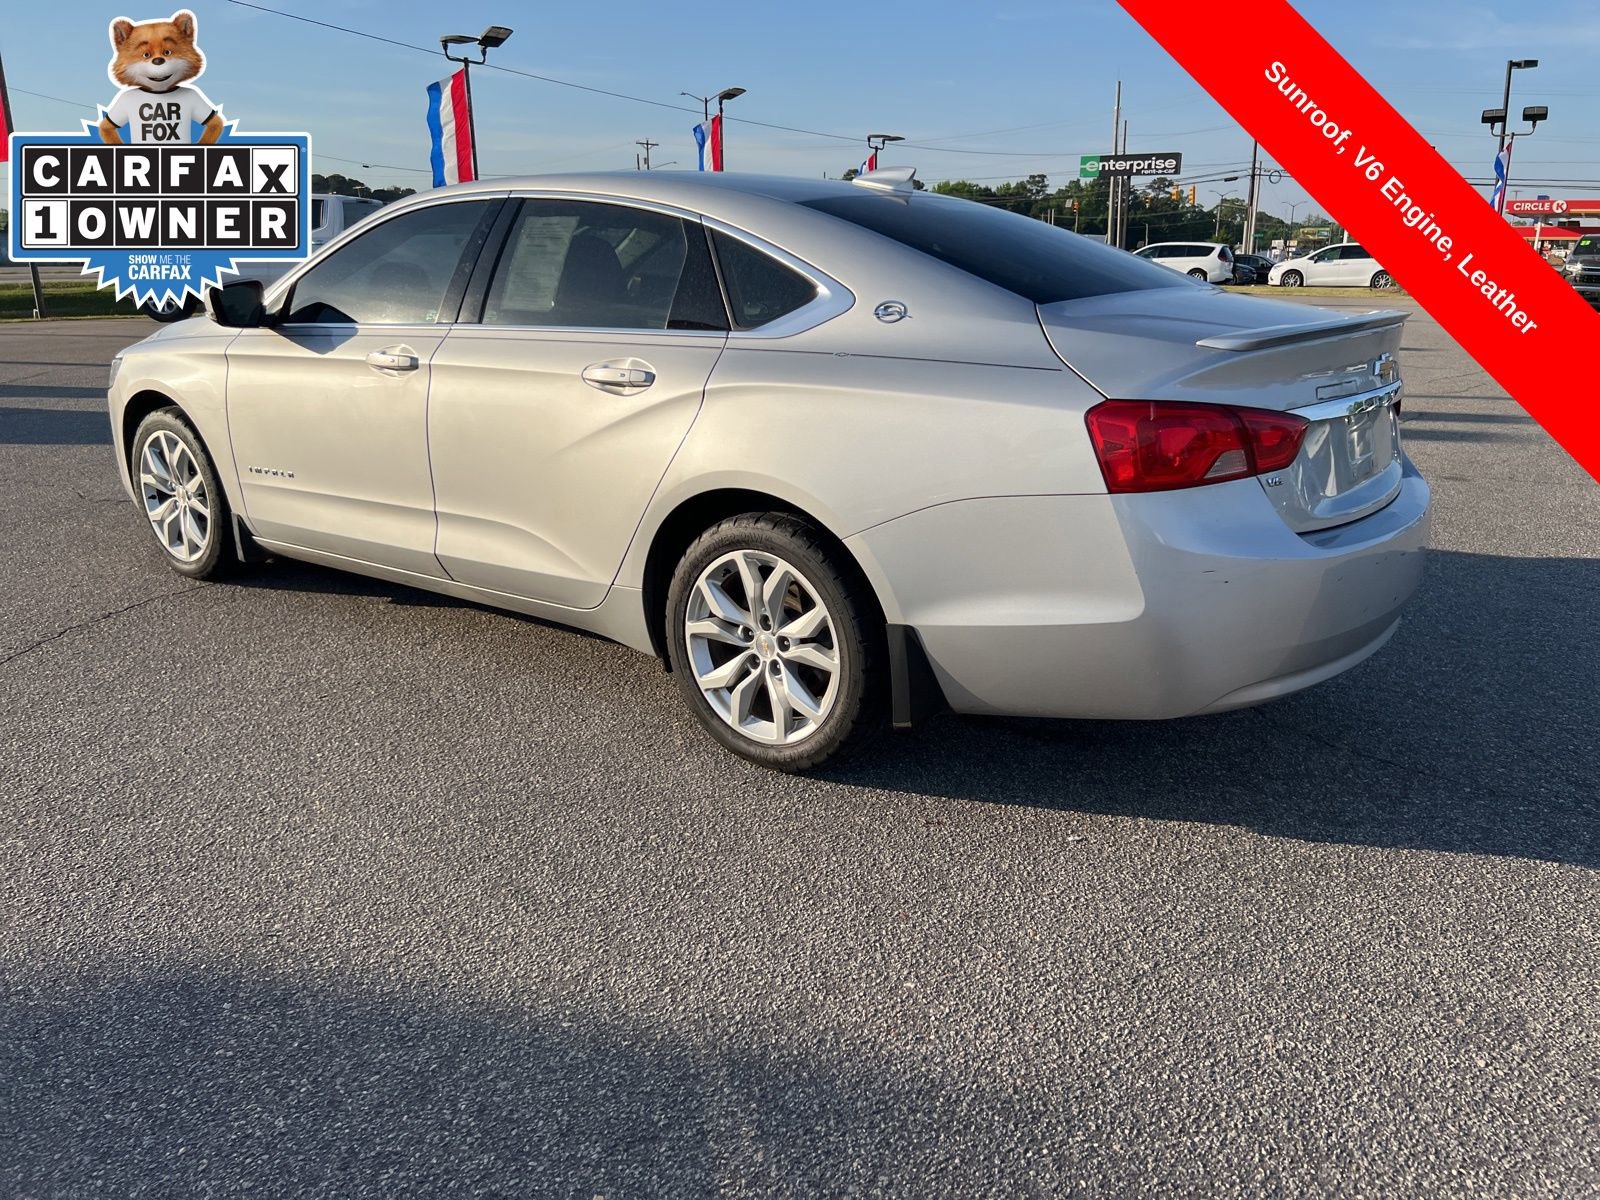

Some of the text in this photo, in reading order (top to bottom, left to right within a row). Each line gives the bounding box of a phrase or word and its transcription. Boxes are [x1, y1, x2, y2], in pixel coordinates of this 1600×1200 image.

[1084, 156, 1177, 173] enterprise
[1513, 201, 1566, 213] CIRCLE K
